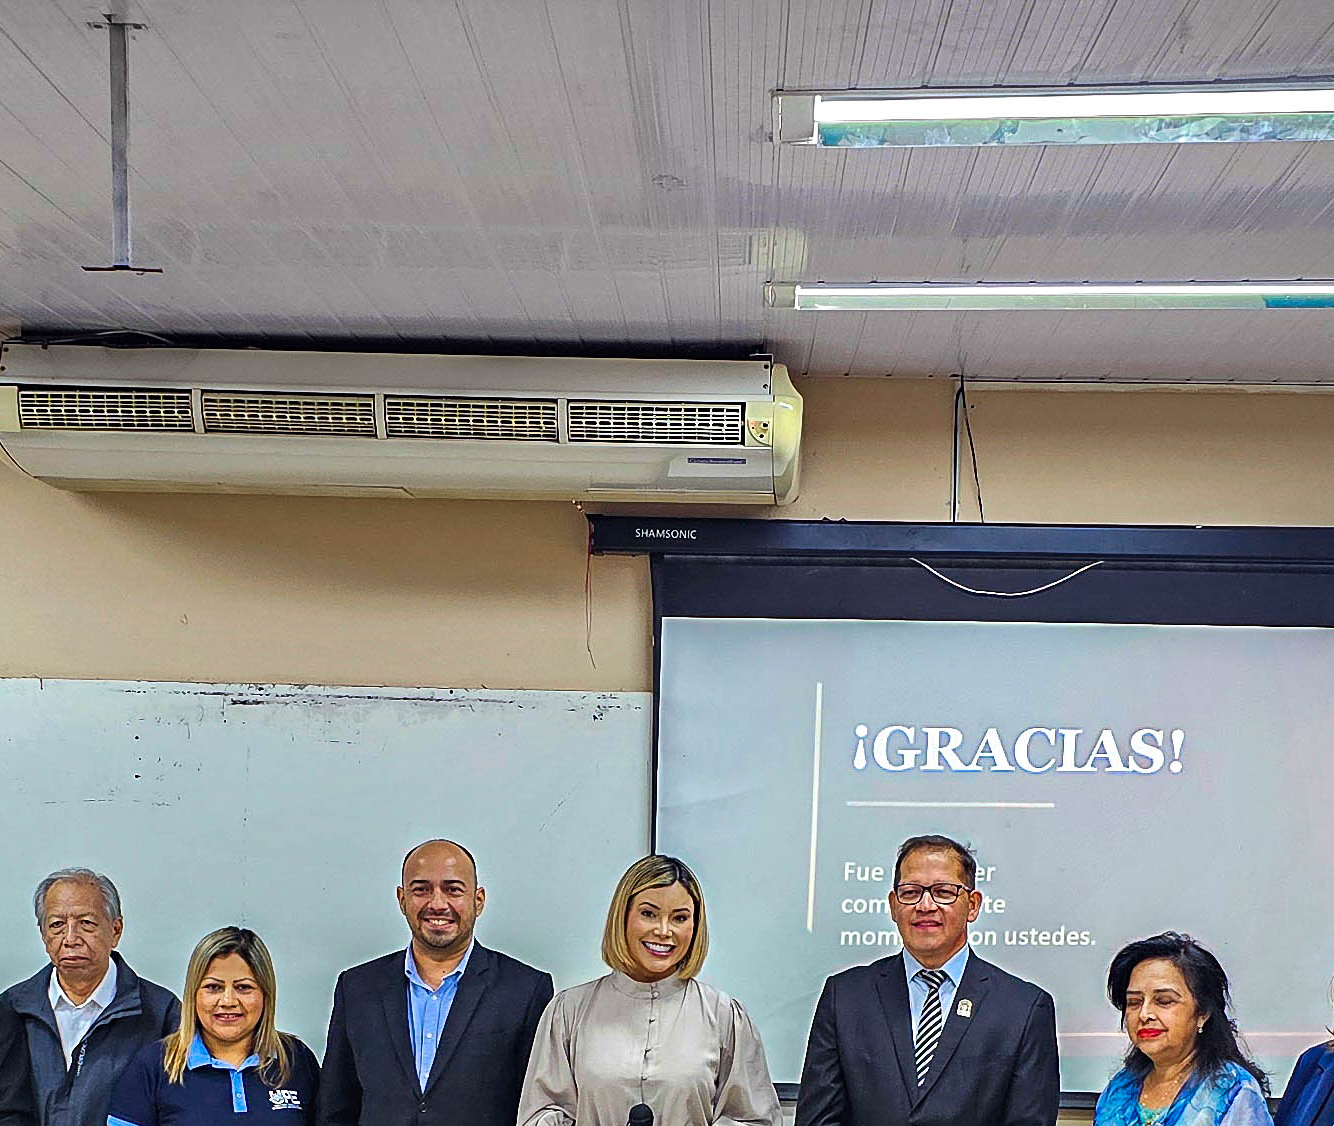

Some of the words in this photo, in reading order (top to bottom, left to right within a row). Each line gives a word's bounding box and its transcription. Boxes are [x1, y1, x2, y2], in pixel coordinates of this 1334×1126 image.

[635, 528, 697, 539] SHAMSONIC
[853, 724, 1185, 774] ¡GRACIAS!
[844, 861, 884, 881] Fue
[969, 930, 997, 946] on
[1004, 925, 1096, 946] ustedes.
